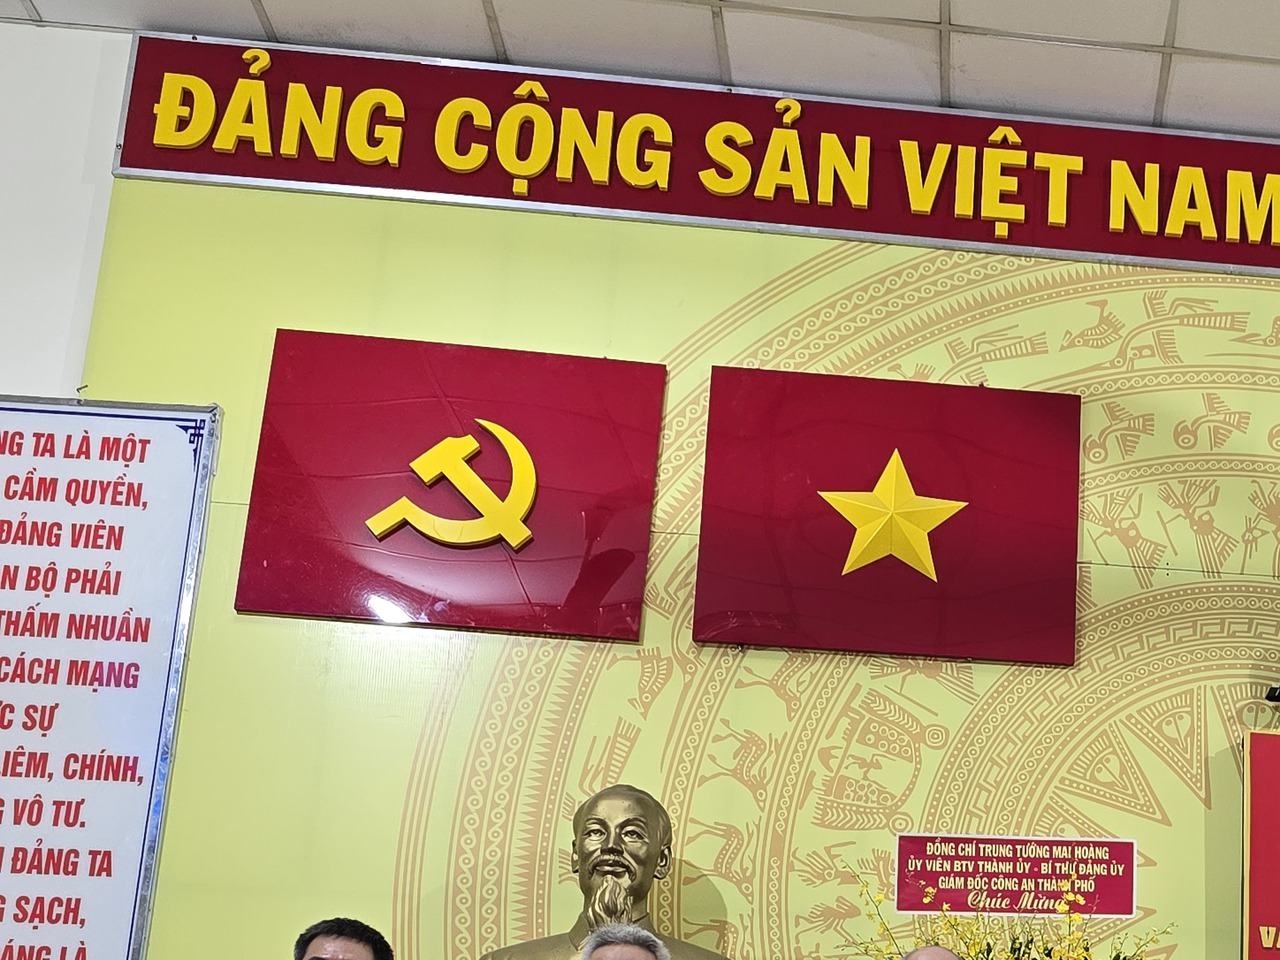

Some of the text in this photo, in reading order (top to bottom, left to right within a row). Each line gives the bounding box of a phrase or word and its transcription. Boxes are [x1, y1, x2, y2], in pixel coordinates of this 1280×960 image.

[153, 49, 404, 165] ĐẢNG
[435, 81, 672, 195] CỘNG
[700, 98, 870, 207] SẢN
[900, 126, 1083, 237] VIỆT
[33, 430, 151, 468] TA LÀ MỘT
[4, 468, 148, 511] CẦM QUYỀN,
[0, 512, 124, 551] ĐẢNG VIÊN
[25, 561, 121, 598] BỘ PHẢI
[66, 607, 150, 643] NHUẦN
[67, 659, 140, 692] MẠNG
[63, 749, 143, 786] CHÍNH,
[10, 838, 112, 877] ĐẢNG TA
[925, 857, 951, 872] VIÊN
[953, 860, 975, 873] BTV
[977, 859, 1013, 874] THÀNH
[1016, 858, 1031, 874] ỦY
[1041, 860, 1052, 875] BÍ
[1079, 861, 1108, 876] ĐẢNG
[1110, 859, 1125, 876] ỦY
[926, 837, 1109, 860] ĐỒNG CHÍ TRUNG TƯỚNG MAI HOÀNG
[938, 875, 964, 890] GIÁM
[967, 872, 990, 890] ĐỐC
[991, 876, 1018, 891] CÔNG
[1021, 878, 1035, 891] AN
[1074, 876, 1095, 893] PHỐ
[13, 896, 85, 929] SẠCH,
